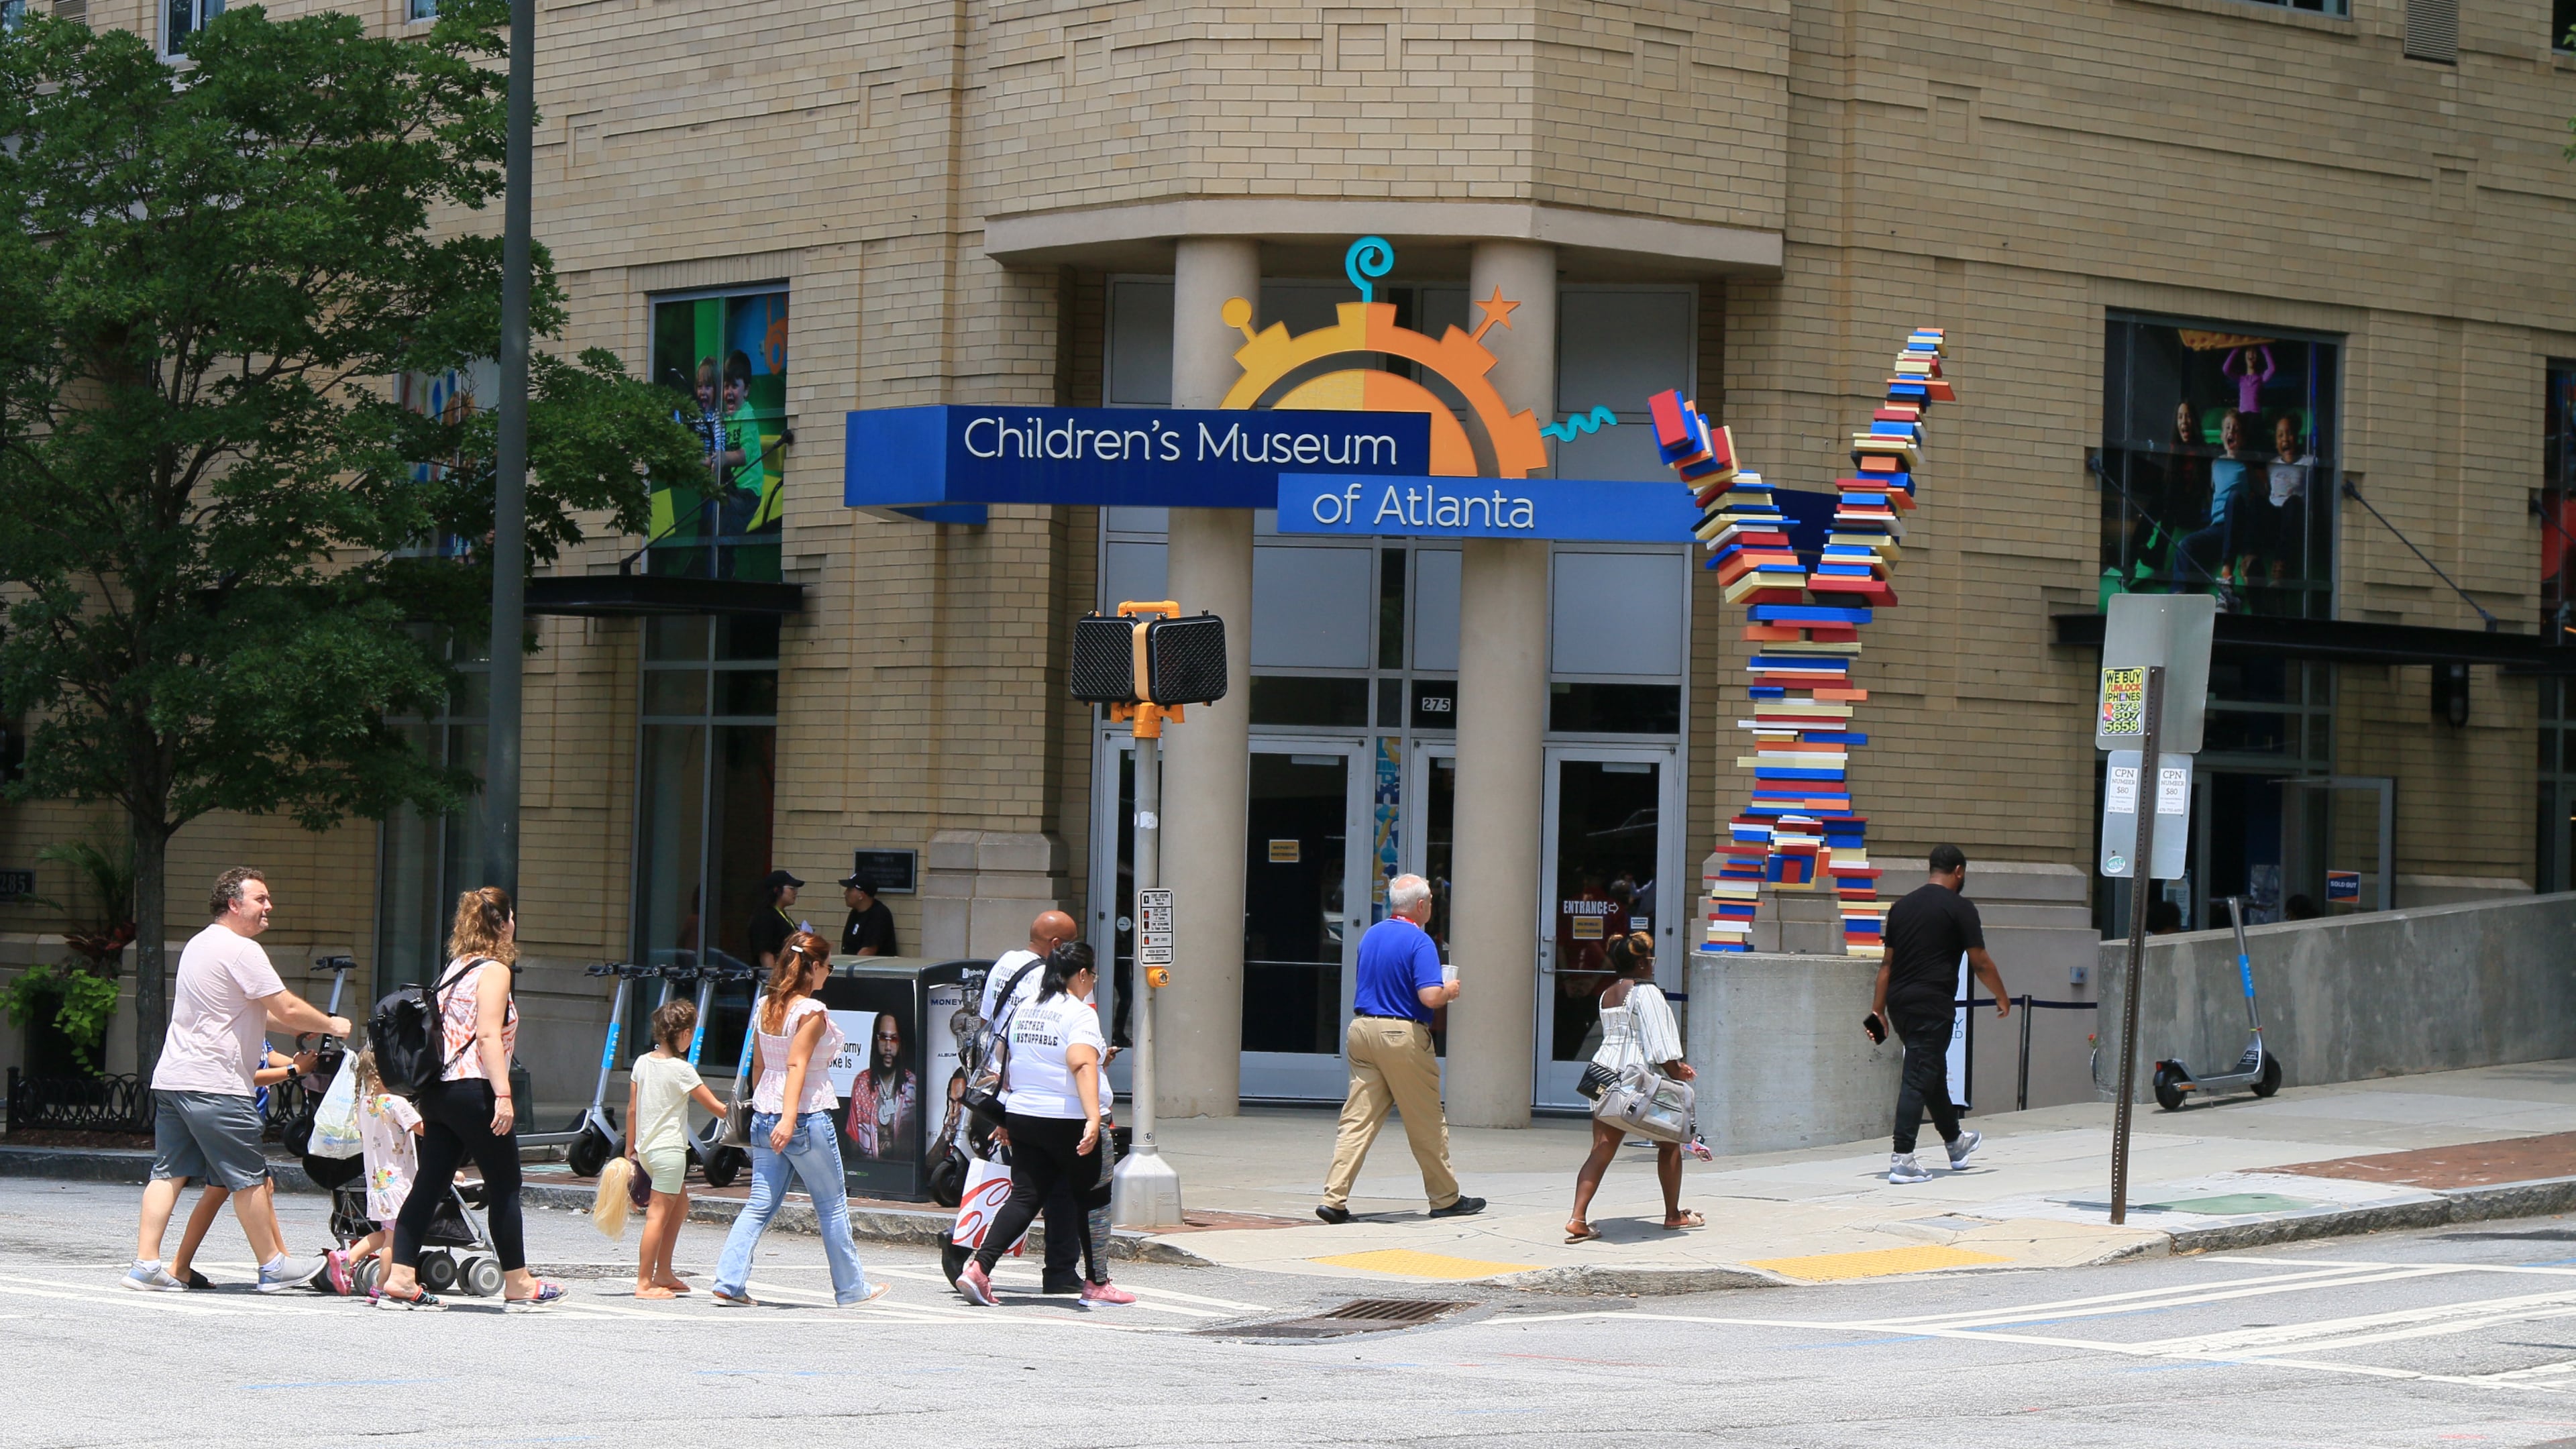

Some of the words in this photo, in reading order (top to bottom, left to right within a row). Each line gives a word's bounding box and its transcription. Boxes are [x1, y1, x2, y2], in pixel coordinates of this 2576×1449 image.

[965, 417, 1180, 461] Children's
[1197, 422, 1397, 465] Museum
[1313, 483, 1362, 523] of
[1374, 486, 1534, 528] Atlanta
[2106, 672, 2120, 684] WE
[2123, 672, 2141, 683] BUY
[1424, 698, 1450, 710] 275
[2112, 702, 2141, 711] 678
[2112, 711, 2140, 720] 607
[2104, 720, 2139, 733] 5658
[2115, 769, 2134, 777] CPN
[2163, 770, 2182, 779] CPN
[1564, 900, 1608, 914] ENTRANCE
[962, 968, 986, 979] Bigbelly
[1017, 1008, 1040, 1019] STRONG
[1039, 1010, 1063, 1023] ALONE
[1014, 1020, 1044, 1031] TOGETHER
[1013, 1033, 1059, 1046] UNSTOPPABLE
[843, 1042, 861, 1057] orny
[845, 1055, 852, 1069] Is
